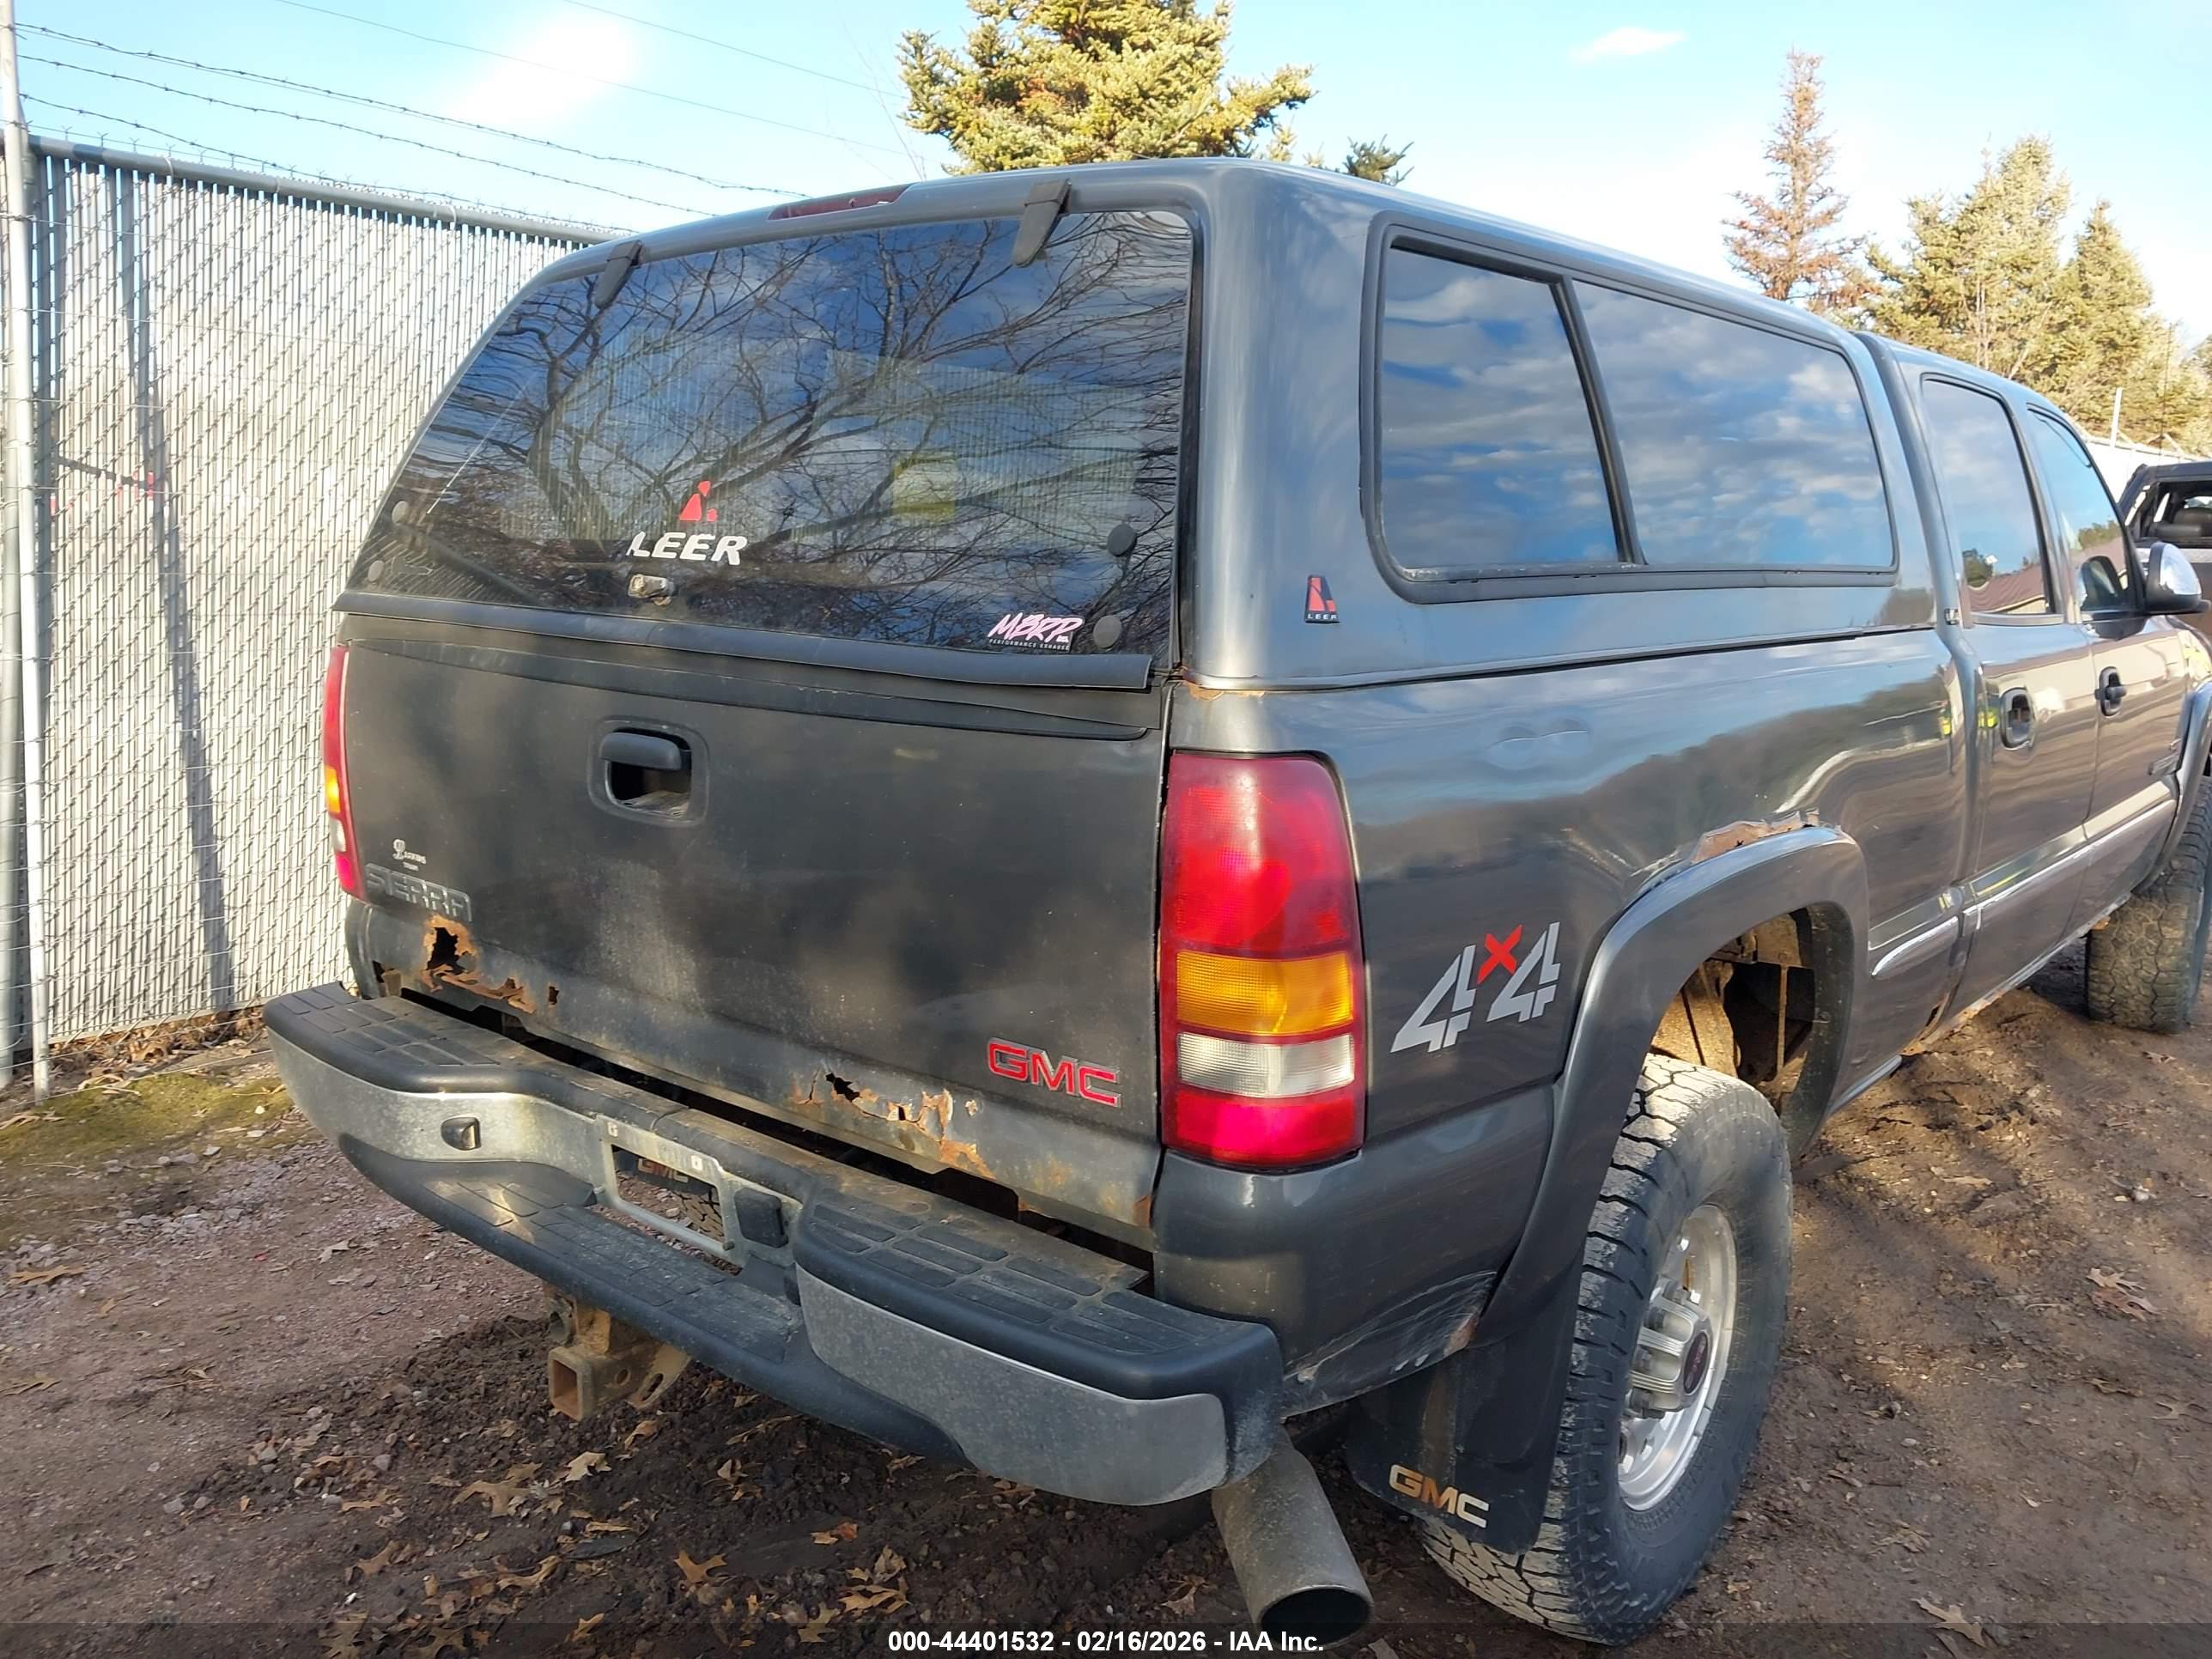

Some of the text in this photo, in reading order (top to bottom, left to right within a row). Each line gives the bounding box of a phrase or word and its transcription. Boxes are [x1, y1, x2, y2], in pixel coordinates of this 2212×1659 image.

[625, 531, 748, 566] LEER
[988, 612, 1084, 643] MBRP
[988, 1038, 1121, 1108] GMC
[1389, 1463, 1490, 1528] GMC
